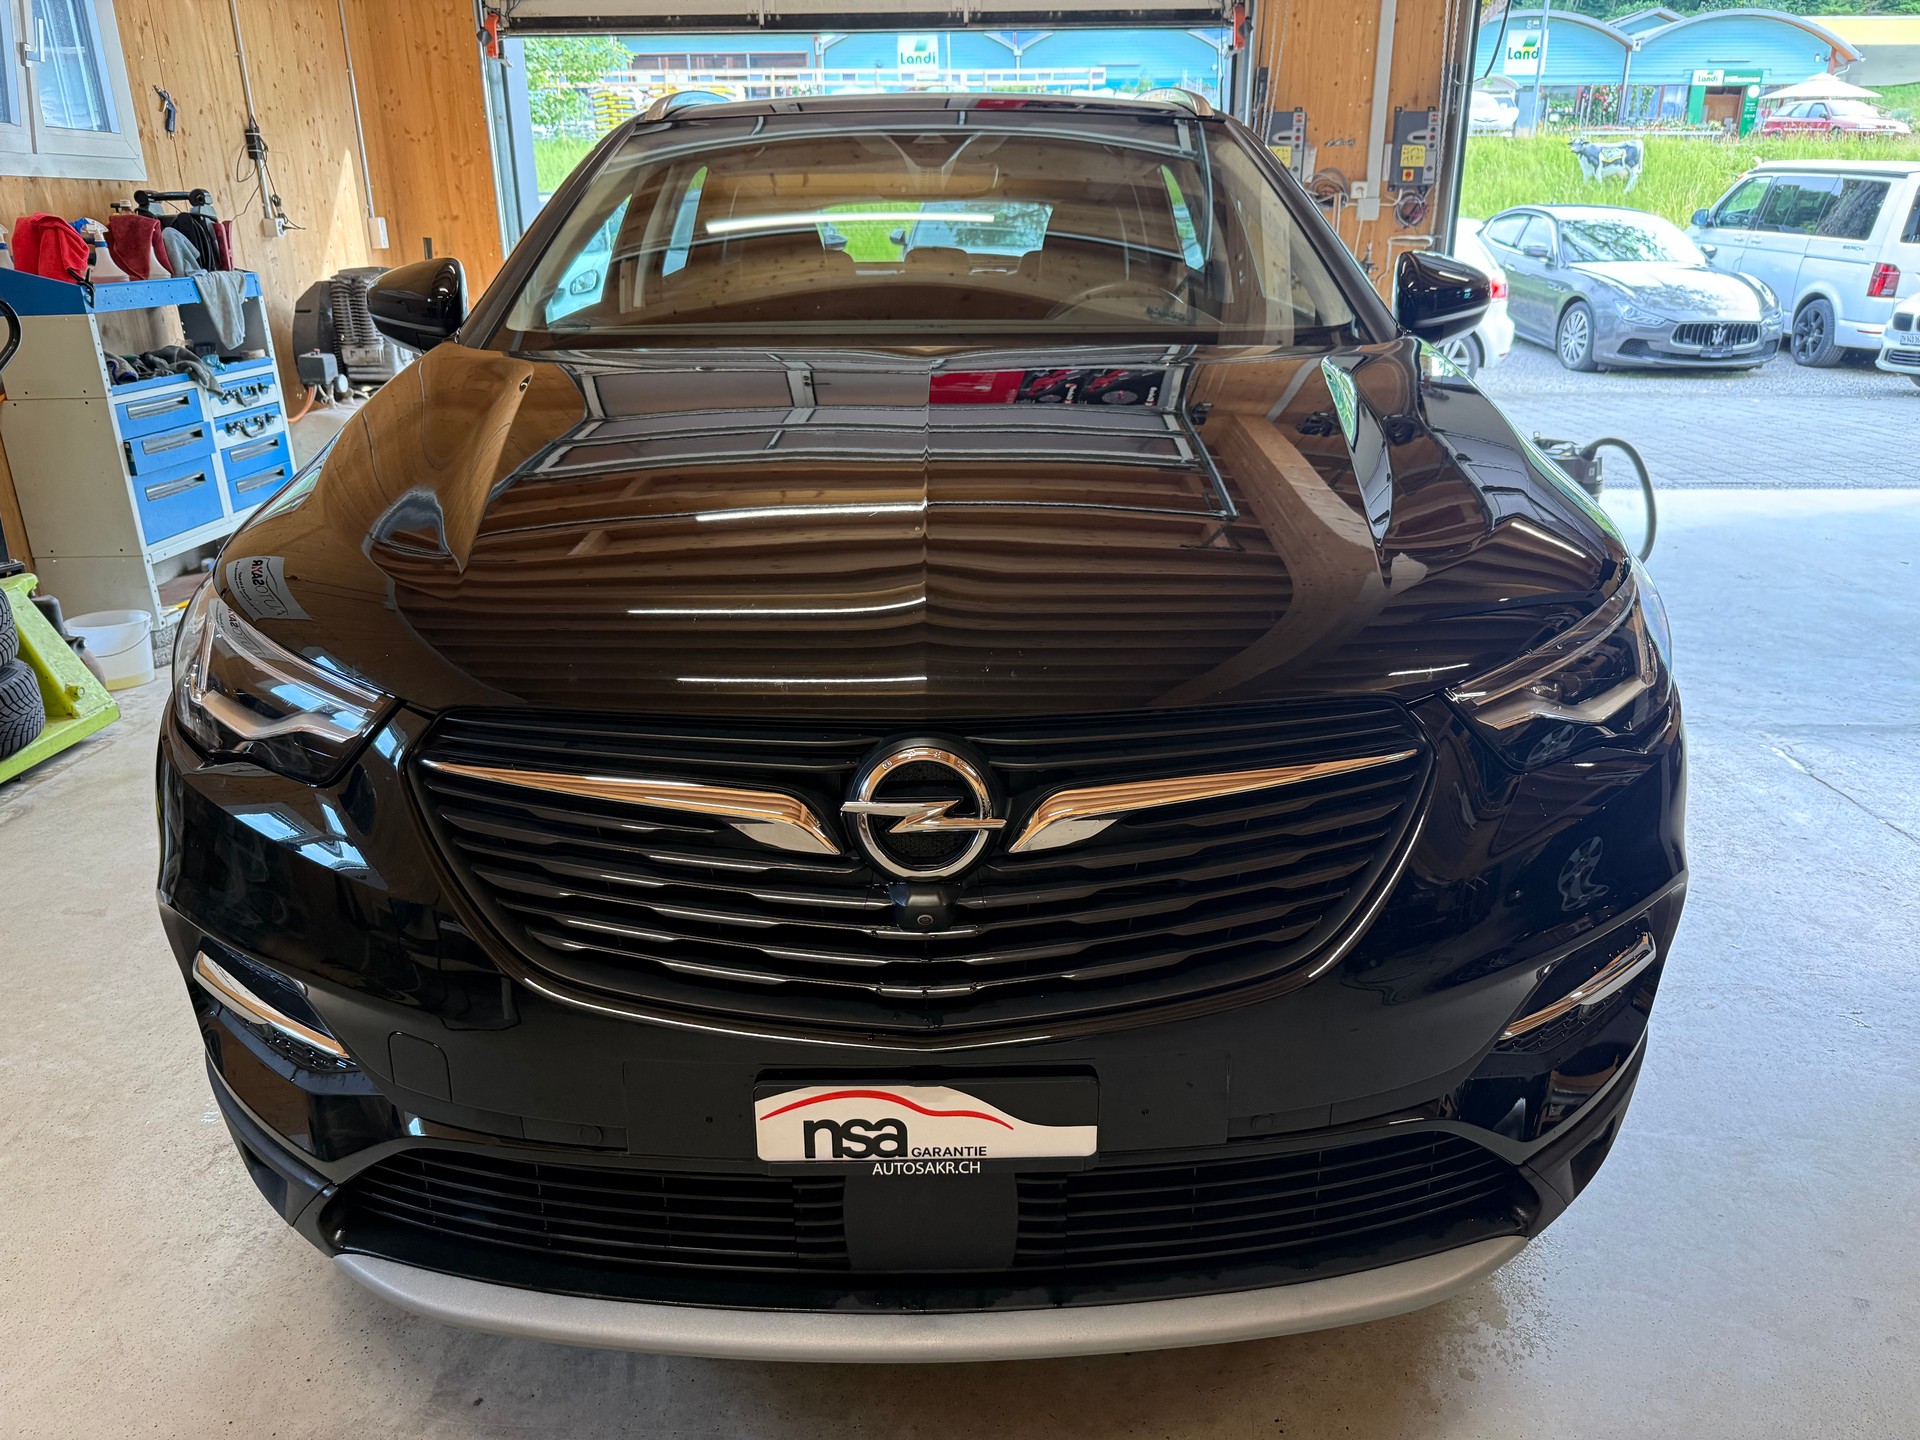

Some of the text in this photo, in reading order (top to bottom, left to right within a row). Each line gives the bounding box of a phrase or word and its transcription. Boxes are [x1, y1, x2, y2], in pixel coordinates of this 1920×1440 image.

[900, 51, 936, 65] Landi
[1507, 46, 1541, 60] Land
[803, 1118, 987, 1159] nsa GARANTIE
[872, 1161, 981, 1175] AUTOSAKR.CH
